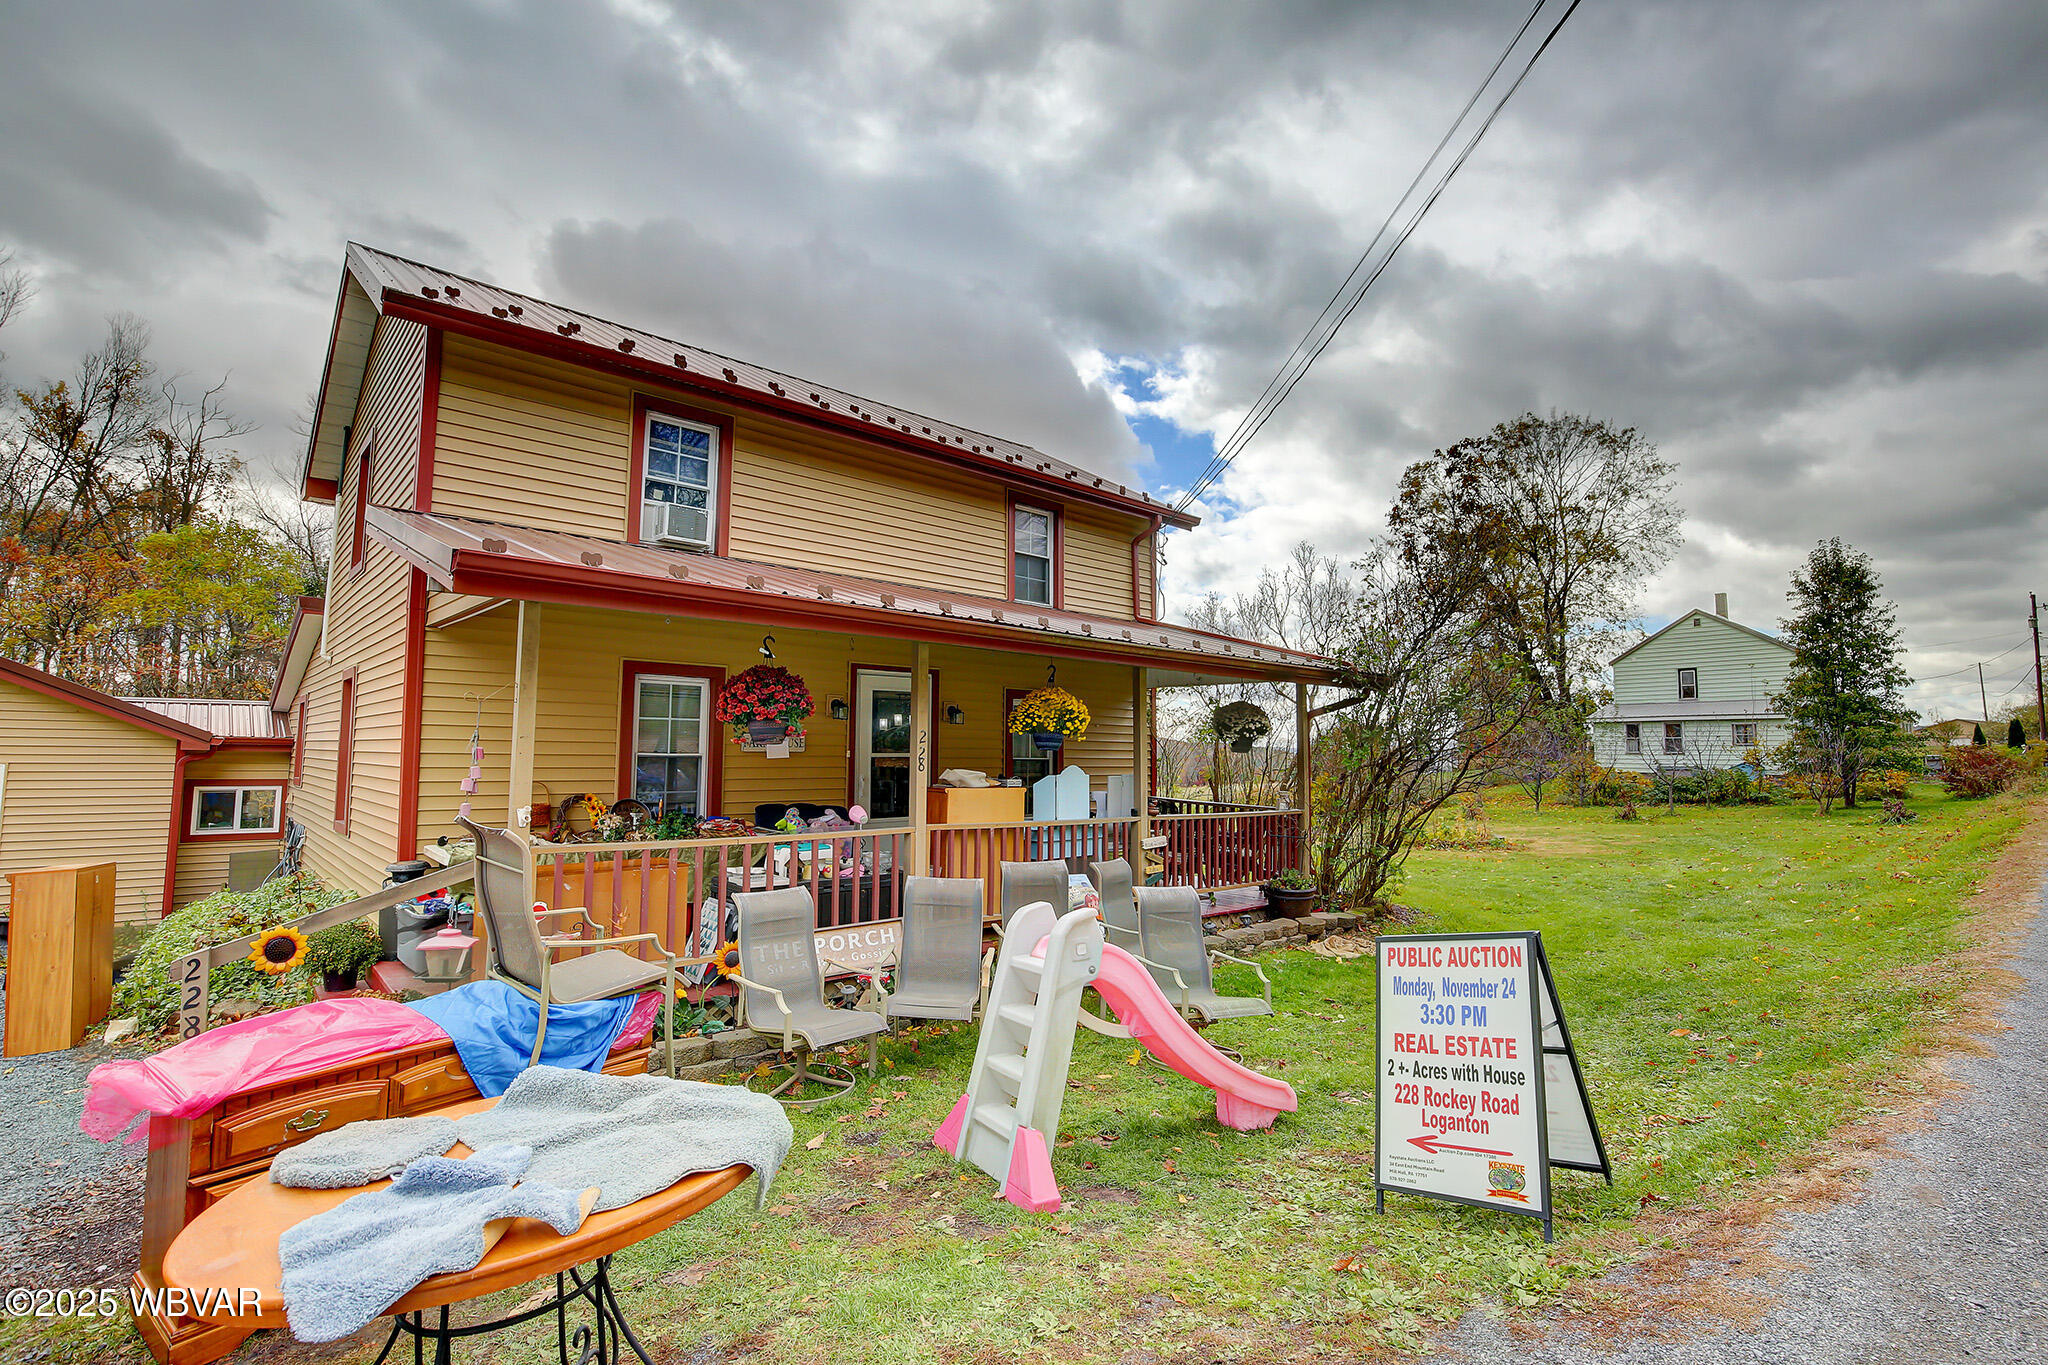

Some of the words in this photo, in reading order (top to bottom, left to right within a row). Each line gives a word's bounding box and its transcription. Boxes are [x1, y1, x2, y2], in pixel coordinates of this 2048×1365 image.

[814, 927, 896, 954] PORCH
[851, 948, 887, 961] Gossi
[1387, 946, 1442, 967] PUBLIC
[1447, 946, 1522, 967] AUCTION
[183, 958, 201, 1039] 228
[1393, 976, 1435, 1002] Monday,
[1442, 977, 1498, 998] November
[1501, 977, 1516, 999] 24
[1420, 1004, 1455, 1025] 3:30
[1461, 1005, 1487, 1027] PM
[1394, 1033, 1439, 1054] REAL
[1445, 1035, 1517, 1059] ESTATE
[1387, 1059, 1395, 1076] 2
[1412, 1061, 1448, 1080] Acres
[1451, 1064, 1479, 1082] with
[1483, 1065, 1525, 1085] House
[1394, 1083, 1419, 1105] 228
[1424, 1086, 1476, 1116] Rockey
[1481, 1091, 1520, 1115] Road
[1421, 1108, 1489, 1134] Loganton
[1488, 1161, 1526, 1176] KEYSTATE
